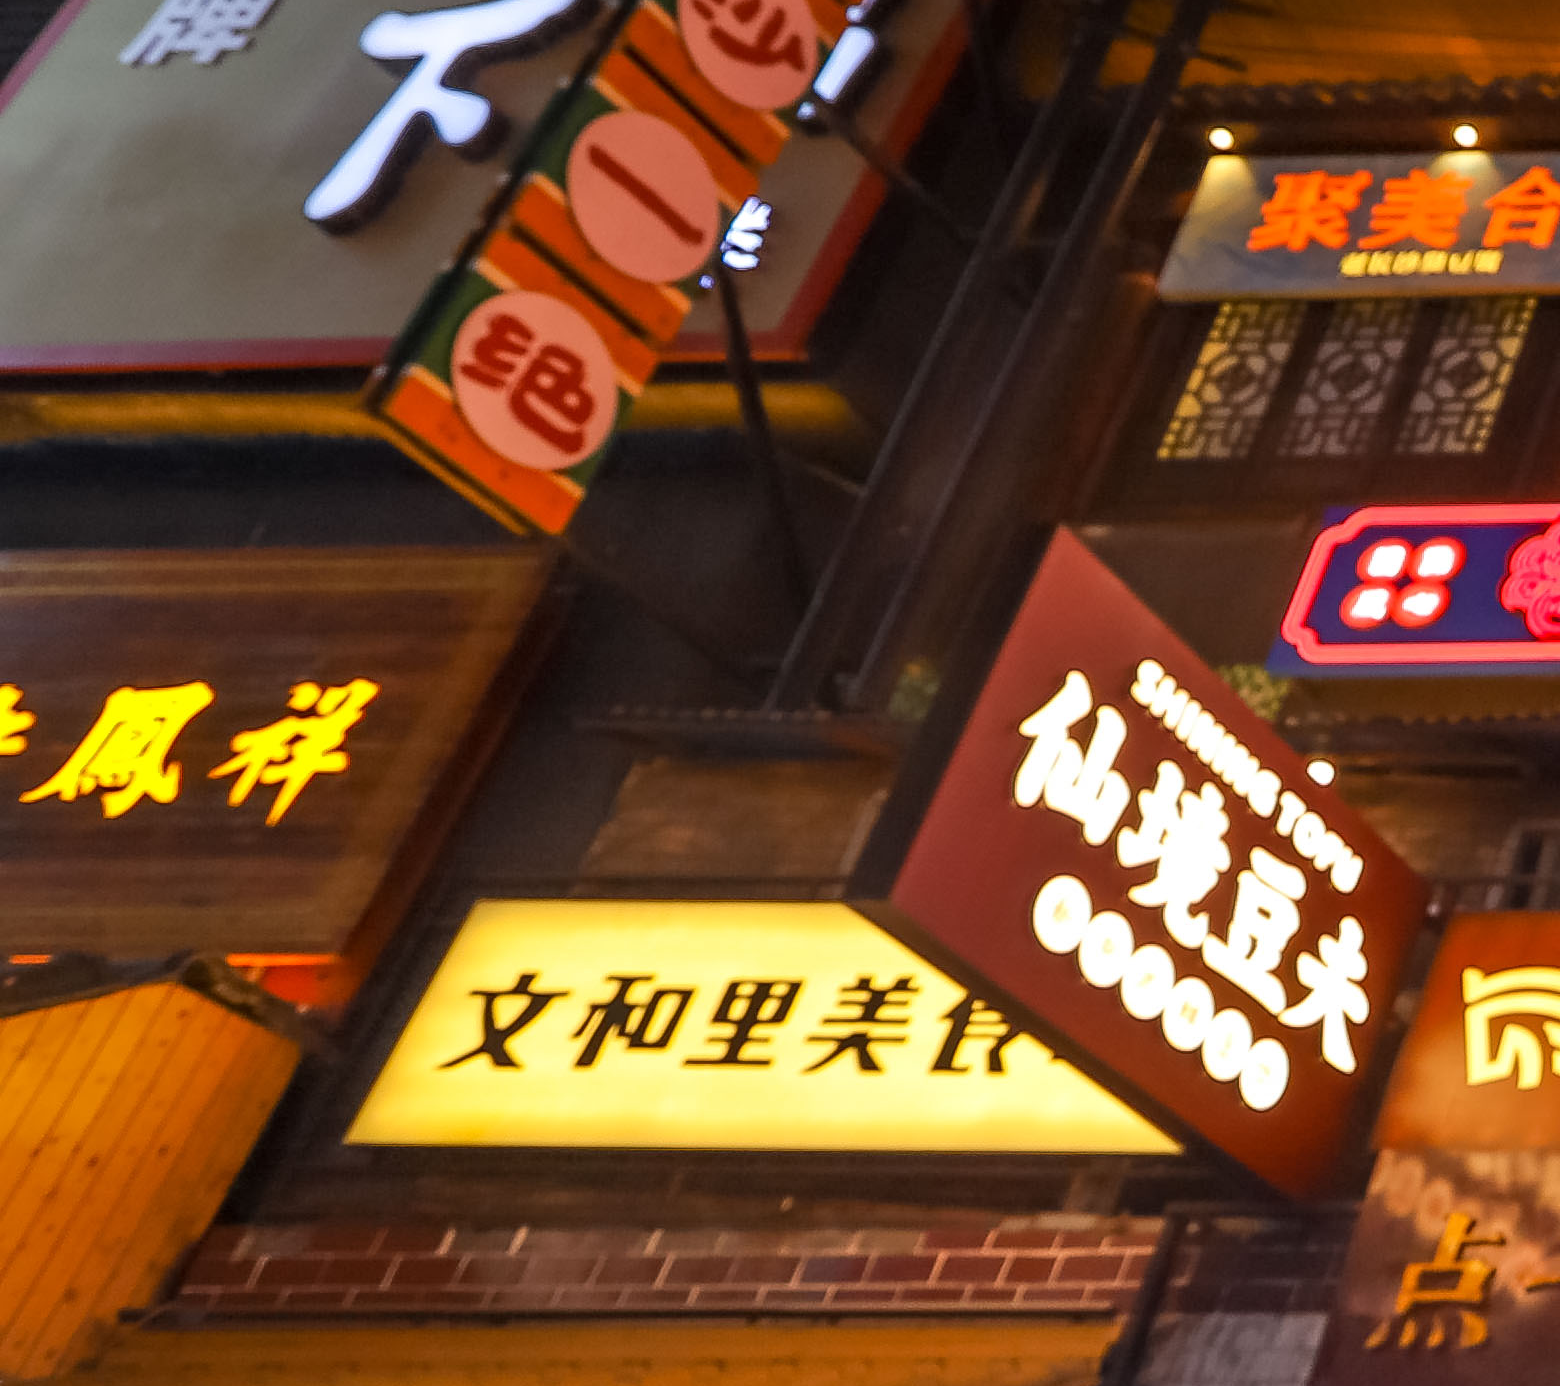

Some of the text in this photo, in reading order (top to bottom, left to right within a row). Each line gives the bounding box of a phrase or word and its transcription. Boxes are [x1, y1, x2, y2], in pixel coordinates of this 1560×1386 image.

[1014, 670, 1369, 1074] 仙境豆夫
[1131, 659, 1281, 817] SHINING
